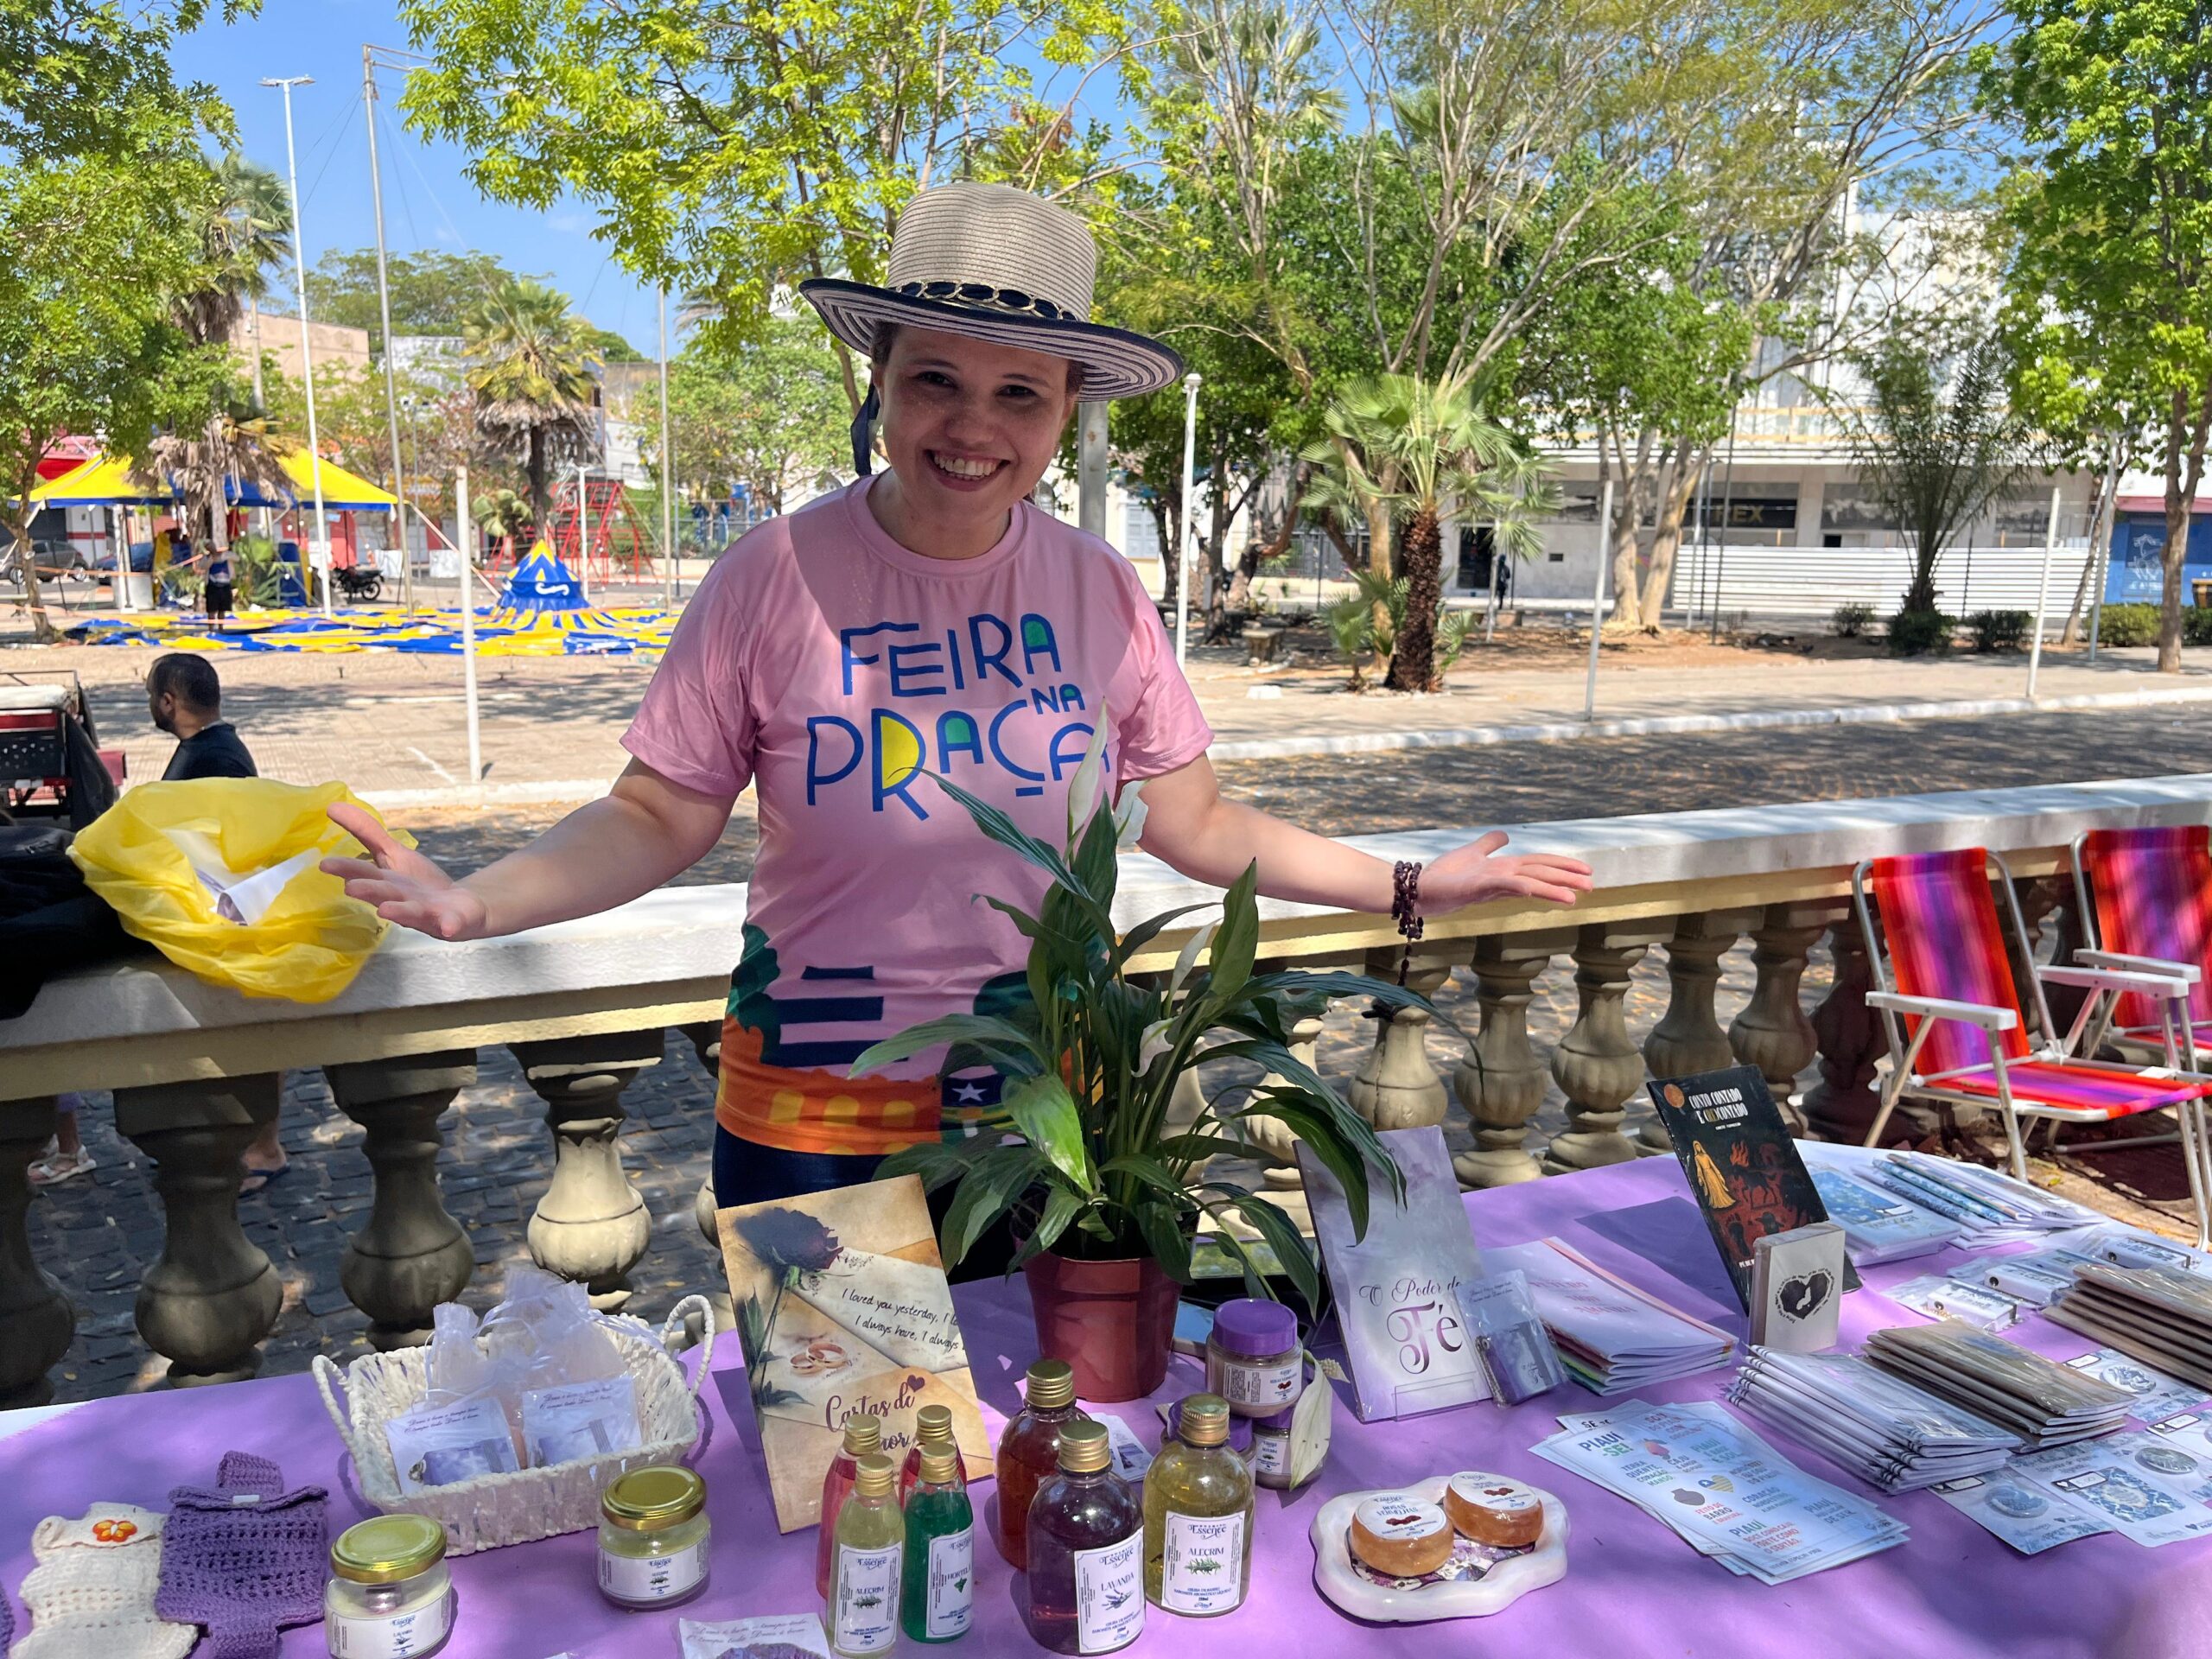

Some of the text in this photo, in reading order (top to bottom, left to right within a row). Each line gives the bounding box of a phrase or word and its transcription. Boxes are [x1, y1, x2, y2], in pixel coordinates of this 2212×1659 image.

[841, 613, 1061, 696] FEIRA
[1031, 683, 1085, 715] NA
[807, 707, 1110, 821] PRAÇA
[1688, 1088, 1742, 1109] CONTO CONTADO
[1391, 1277, 1441, 1303] Poder
[842, 1288, 848, 1299] I
[849, 1289, 874, 1305] loved
[875, 1300, 893, 1312] you
[894, 1304, 938, 1325] yesterday,
[855, 1315, 861, 1325] I
[861, 1316, 892, 1338] always
[894, 1325, 917, 1341] have,
[929, 1334, 959, 1352] always
[825, 1382, 915, 1433] Cartas de
[1578, 1431, 1625, 1452] PIAUÍ
[1703, 1507, 1732, 1521] BARRO
[1729, 1519, 1767, 1537] PIAUÍ
[1188, 1547, 1224, 1556] ALECRIM
[1101, 1572, 1135, 1592] LAVANDA
